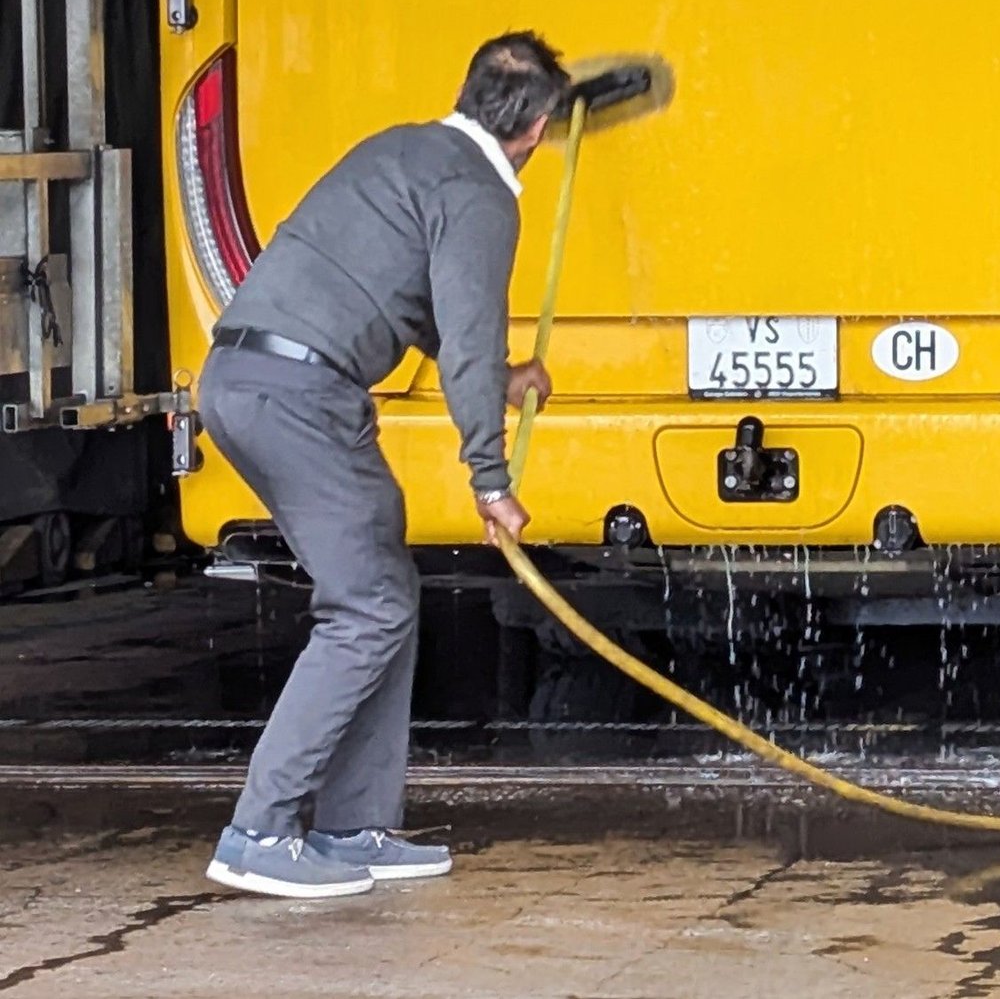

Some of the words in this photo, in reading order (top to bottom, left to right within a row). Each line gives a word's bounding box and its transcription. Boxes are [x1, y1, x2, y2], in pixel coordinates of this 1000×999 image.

[745, 316, 780, 344] VS
[891, 329, 936, 371] CH
[709, 351, 817, 388] 45555
